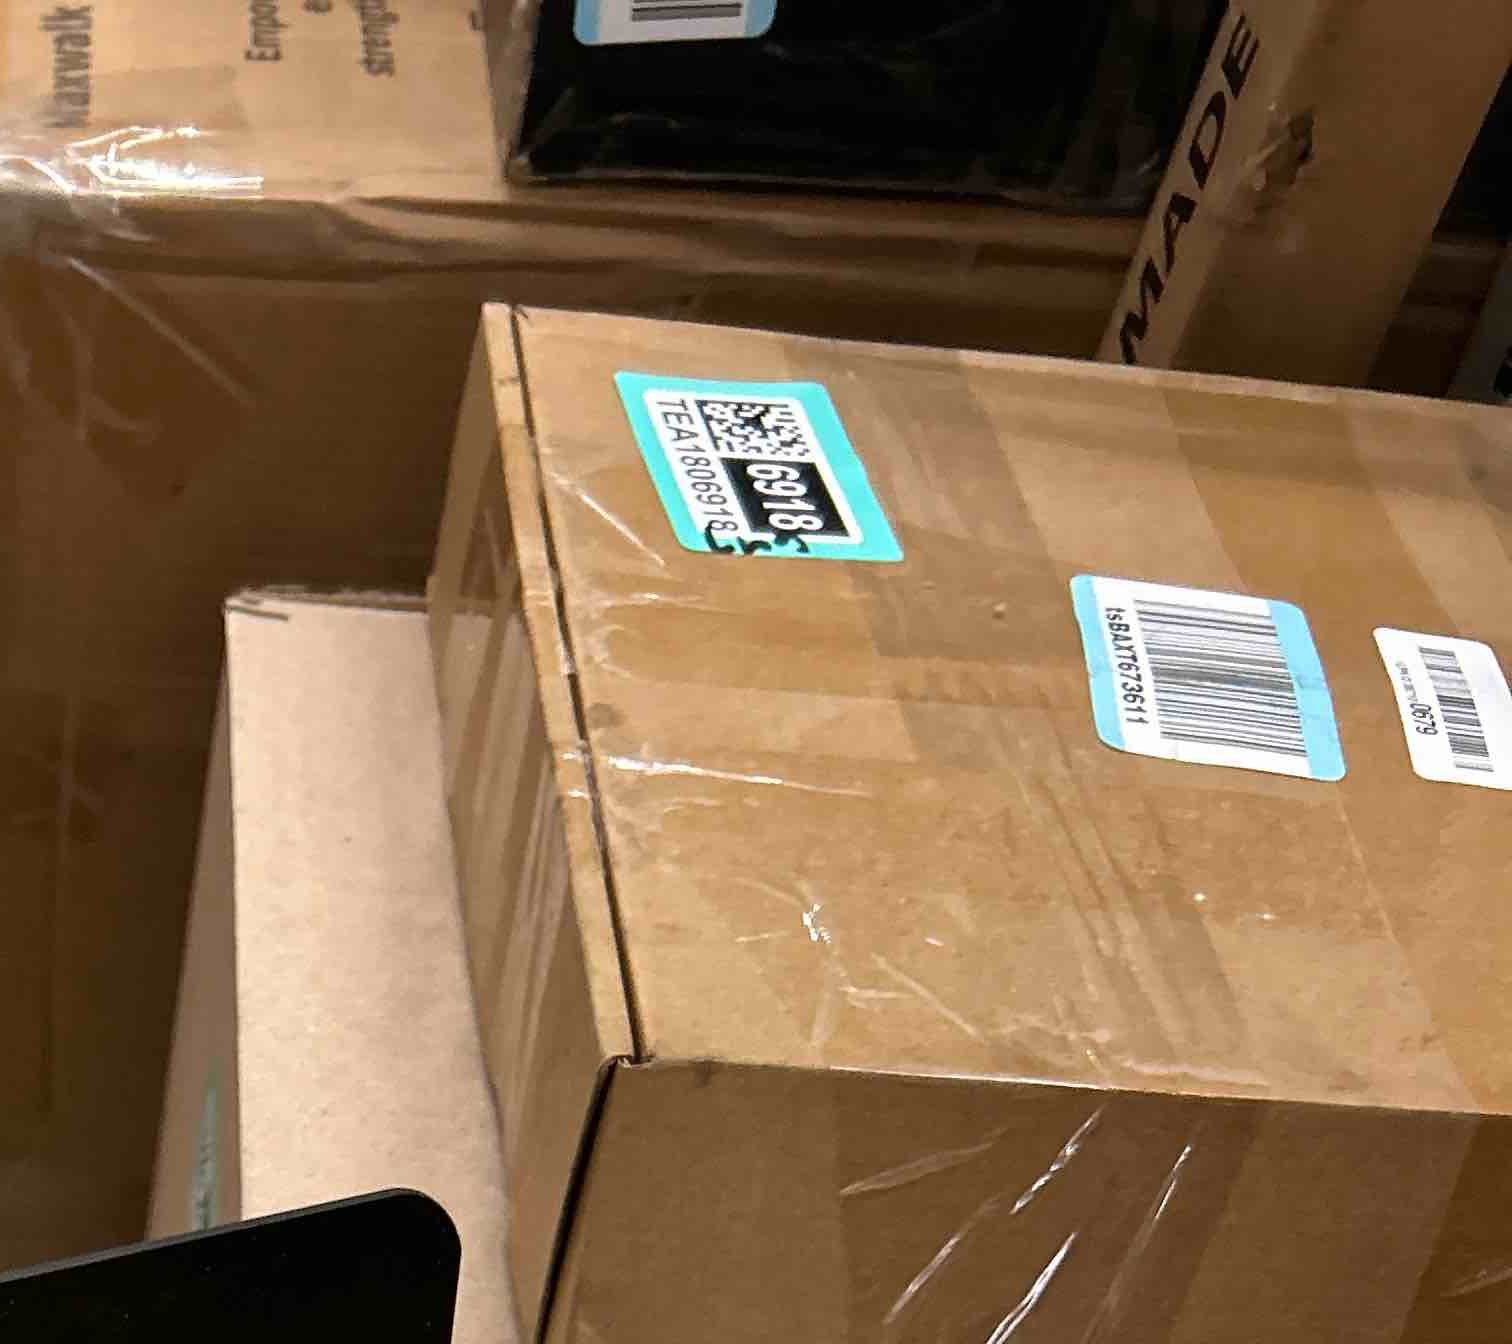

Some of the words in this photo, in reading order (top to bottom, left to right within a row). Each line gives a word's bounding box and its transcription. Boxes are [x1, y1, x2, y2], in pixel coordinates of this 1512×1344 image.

[1119, 14, 1260, 366] MADE
[655, 399, 738, 532] TEA1806918
[745, 463, 825, 531] 6918
[1104, 606, 1150, 724] tsBAXT673611
